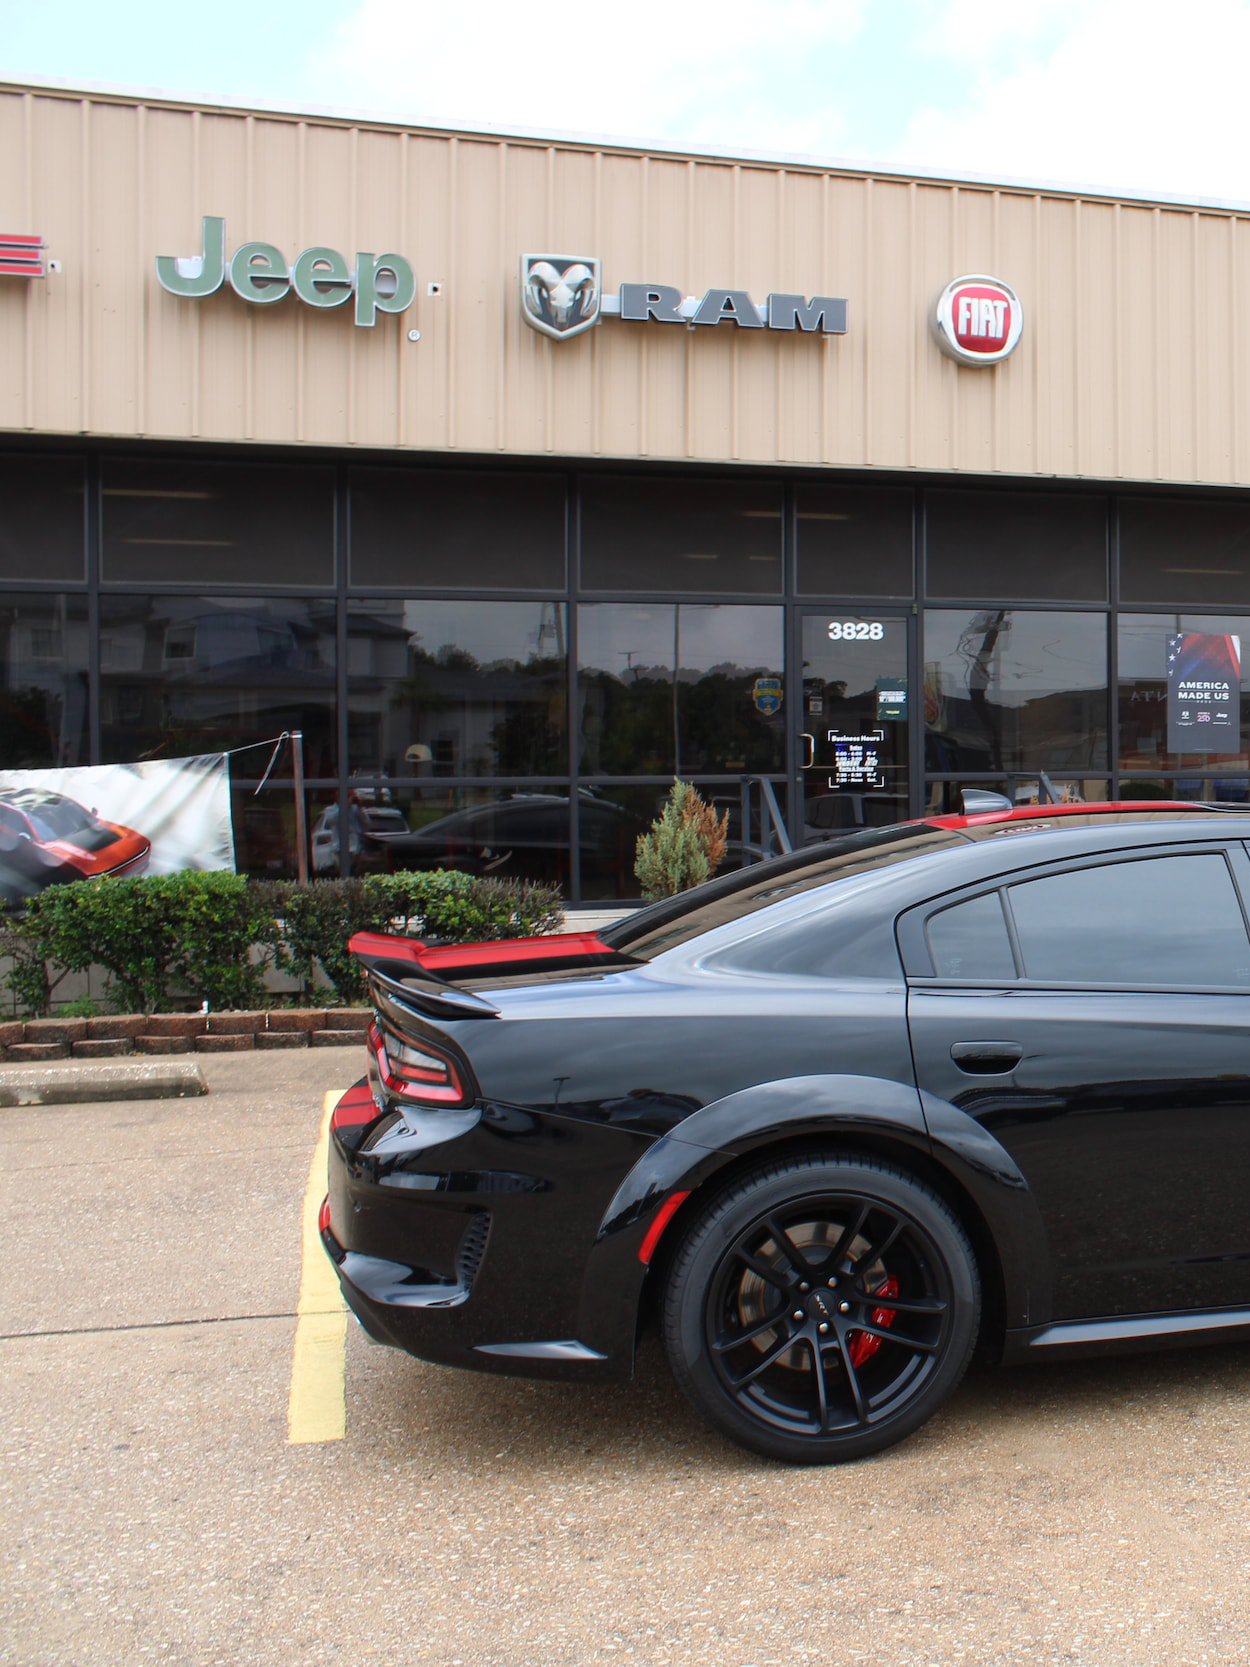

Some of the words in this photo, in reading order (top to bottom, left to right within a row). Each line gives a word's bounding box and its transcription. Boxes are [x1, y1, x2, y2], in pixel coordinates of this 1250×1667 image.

[155, 215, 416, 327] Jeep
[619, 282, 849, 335] RAM
[958, 296, 1008, 338] FIAT
[828, 622, 884, 641] 3828
[1178, 681, 1230, 690] AMERICA
[1178, 691, 1211, 700] MADE
[1214, 692, 1230, 701] US
